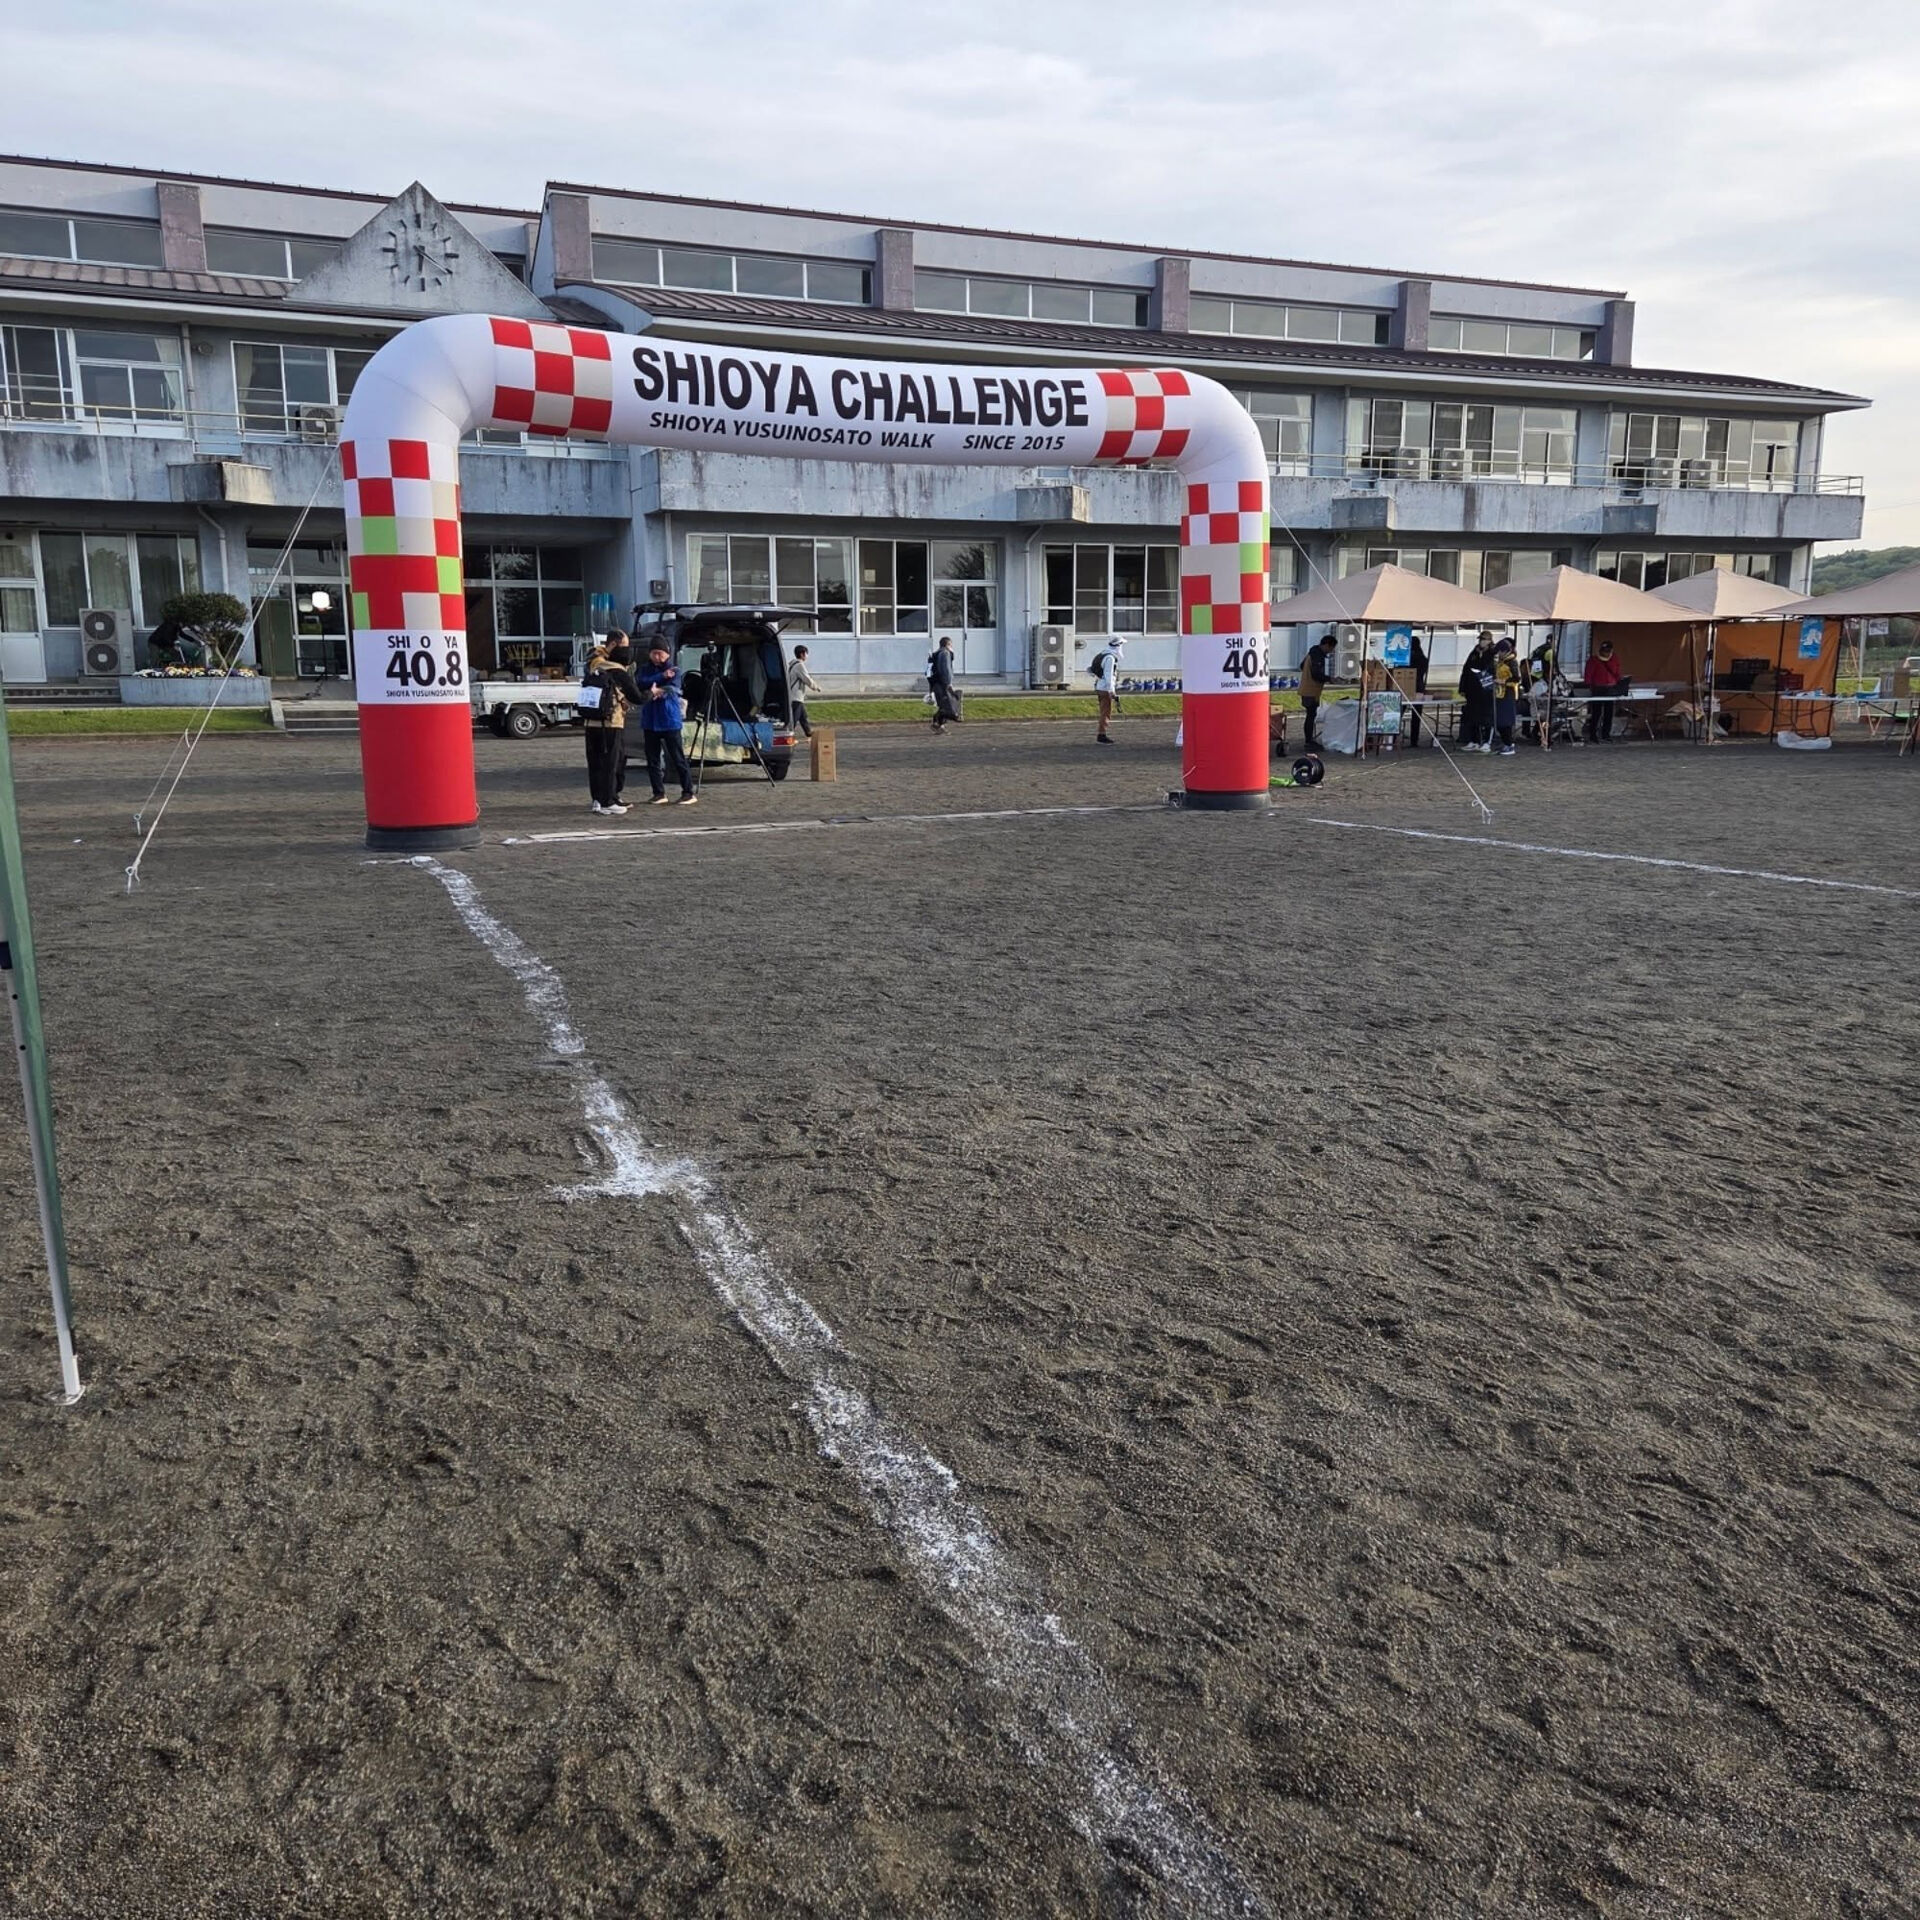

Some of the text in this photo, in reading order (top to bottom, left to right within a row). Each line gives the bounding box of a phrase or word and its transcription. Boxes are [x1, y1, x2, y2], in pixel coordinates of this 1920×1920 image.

[632, 347, 1089, 427] SHIOYA CHALLENGE
[650, 411, 1065, 450] SHIOYA YUSUINOSATO WALK SINCE 2015
[387, 635, 411, 648] SHI
[1225, 637, 1243, 649] SHI
[386, 650, 462, 687] 40.8
